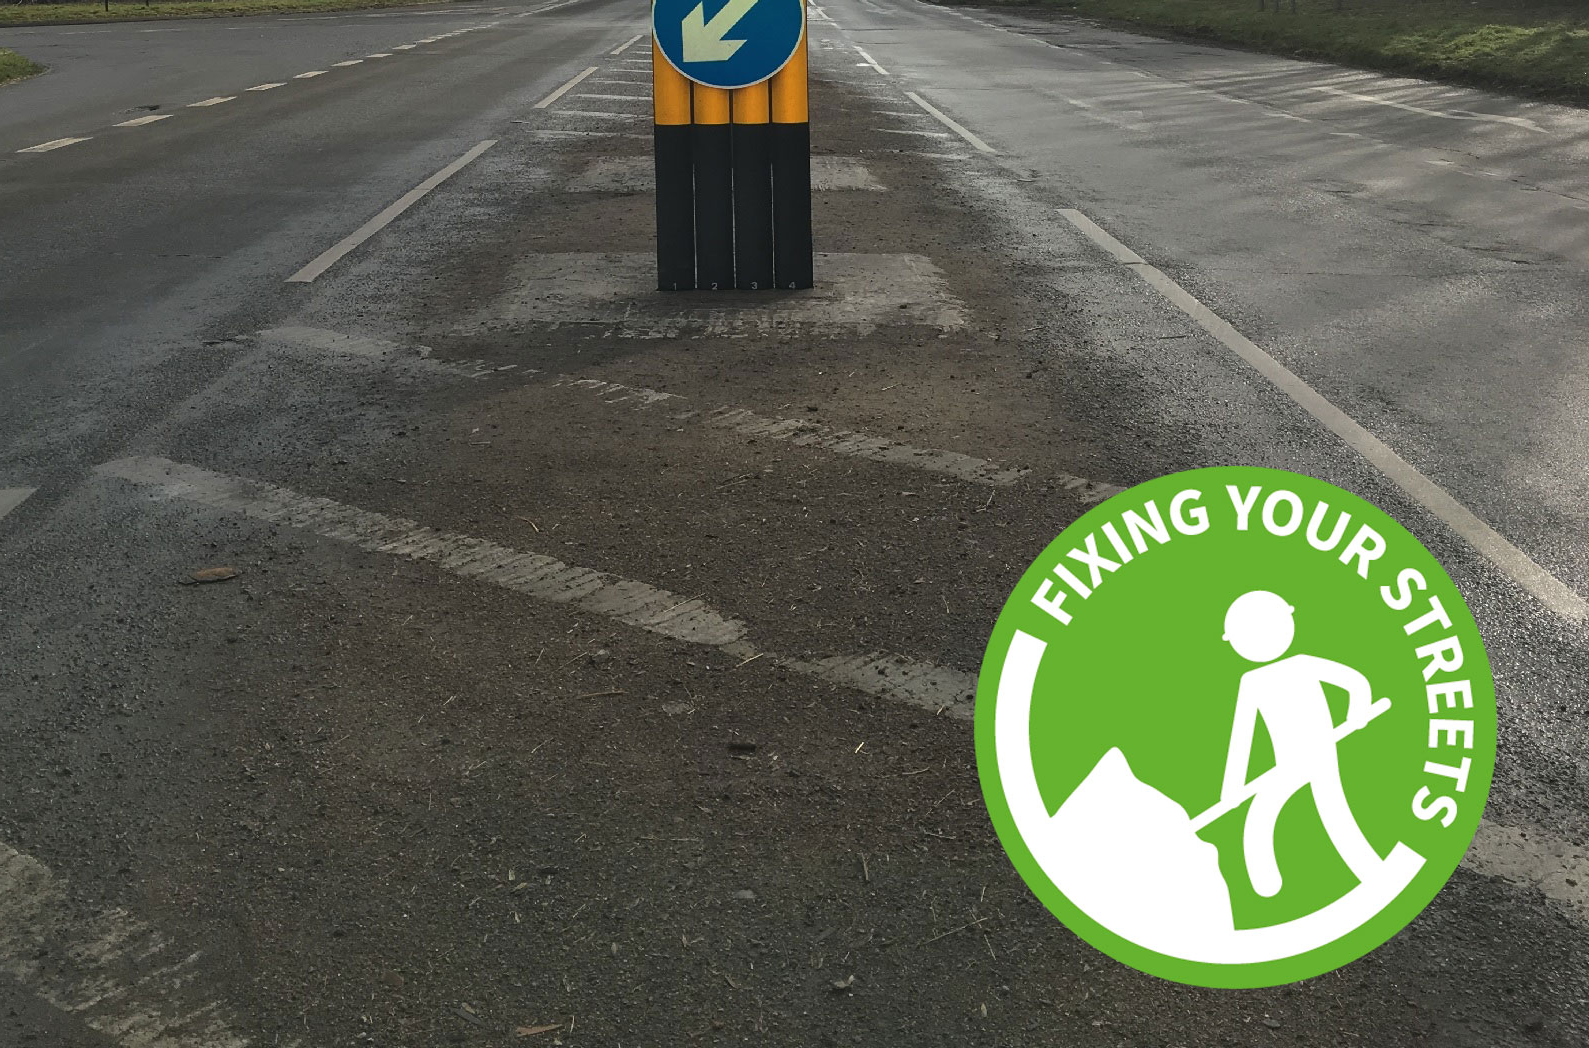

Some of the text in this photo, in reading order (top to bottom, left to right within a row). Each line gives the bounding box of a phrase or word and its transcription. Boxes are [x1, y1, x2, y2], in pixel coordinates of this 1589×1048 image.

[711, 282, 718, 290] 2
[751, 281, 758, 290] 3
[788, 281, 796, 289] 4
